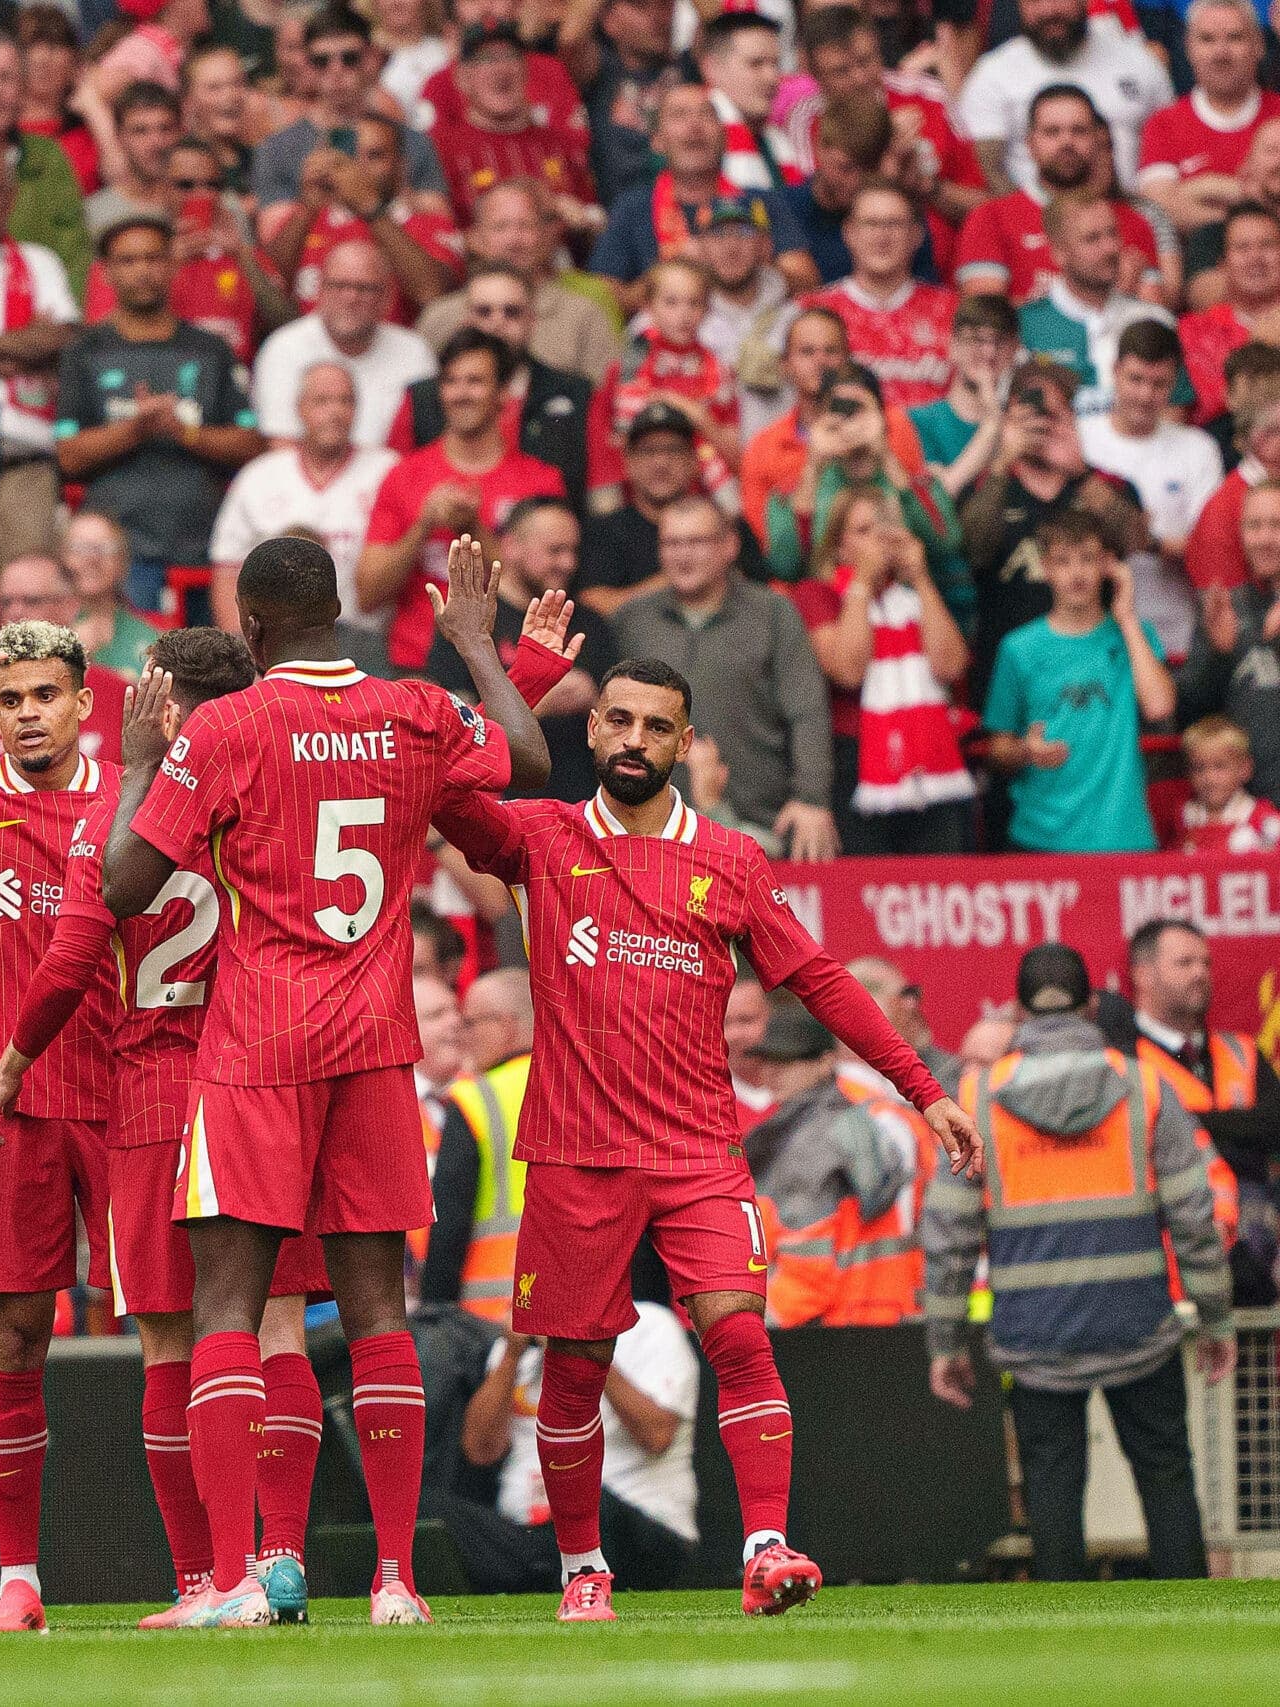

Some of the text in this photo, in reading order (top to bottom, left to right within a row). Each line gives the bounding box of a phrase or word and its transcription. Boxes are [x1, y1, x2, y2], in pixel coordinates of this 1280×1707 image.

[292, 721, 396, 762] KONATÉ
[160, 757, 199, 791] edia
[313, 798, 385, 943] 5
[608, 928, 699, 958] standard
[606, 946, 703, 976] chartered
[369, 1429, 402, 1440] LFC
[257, 1449, 284, 1459] LFC
